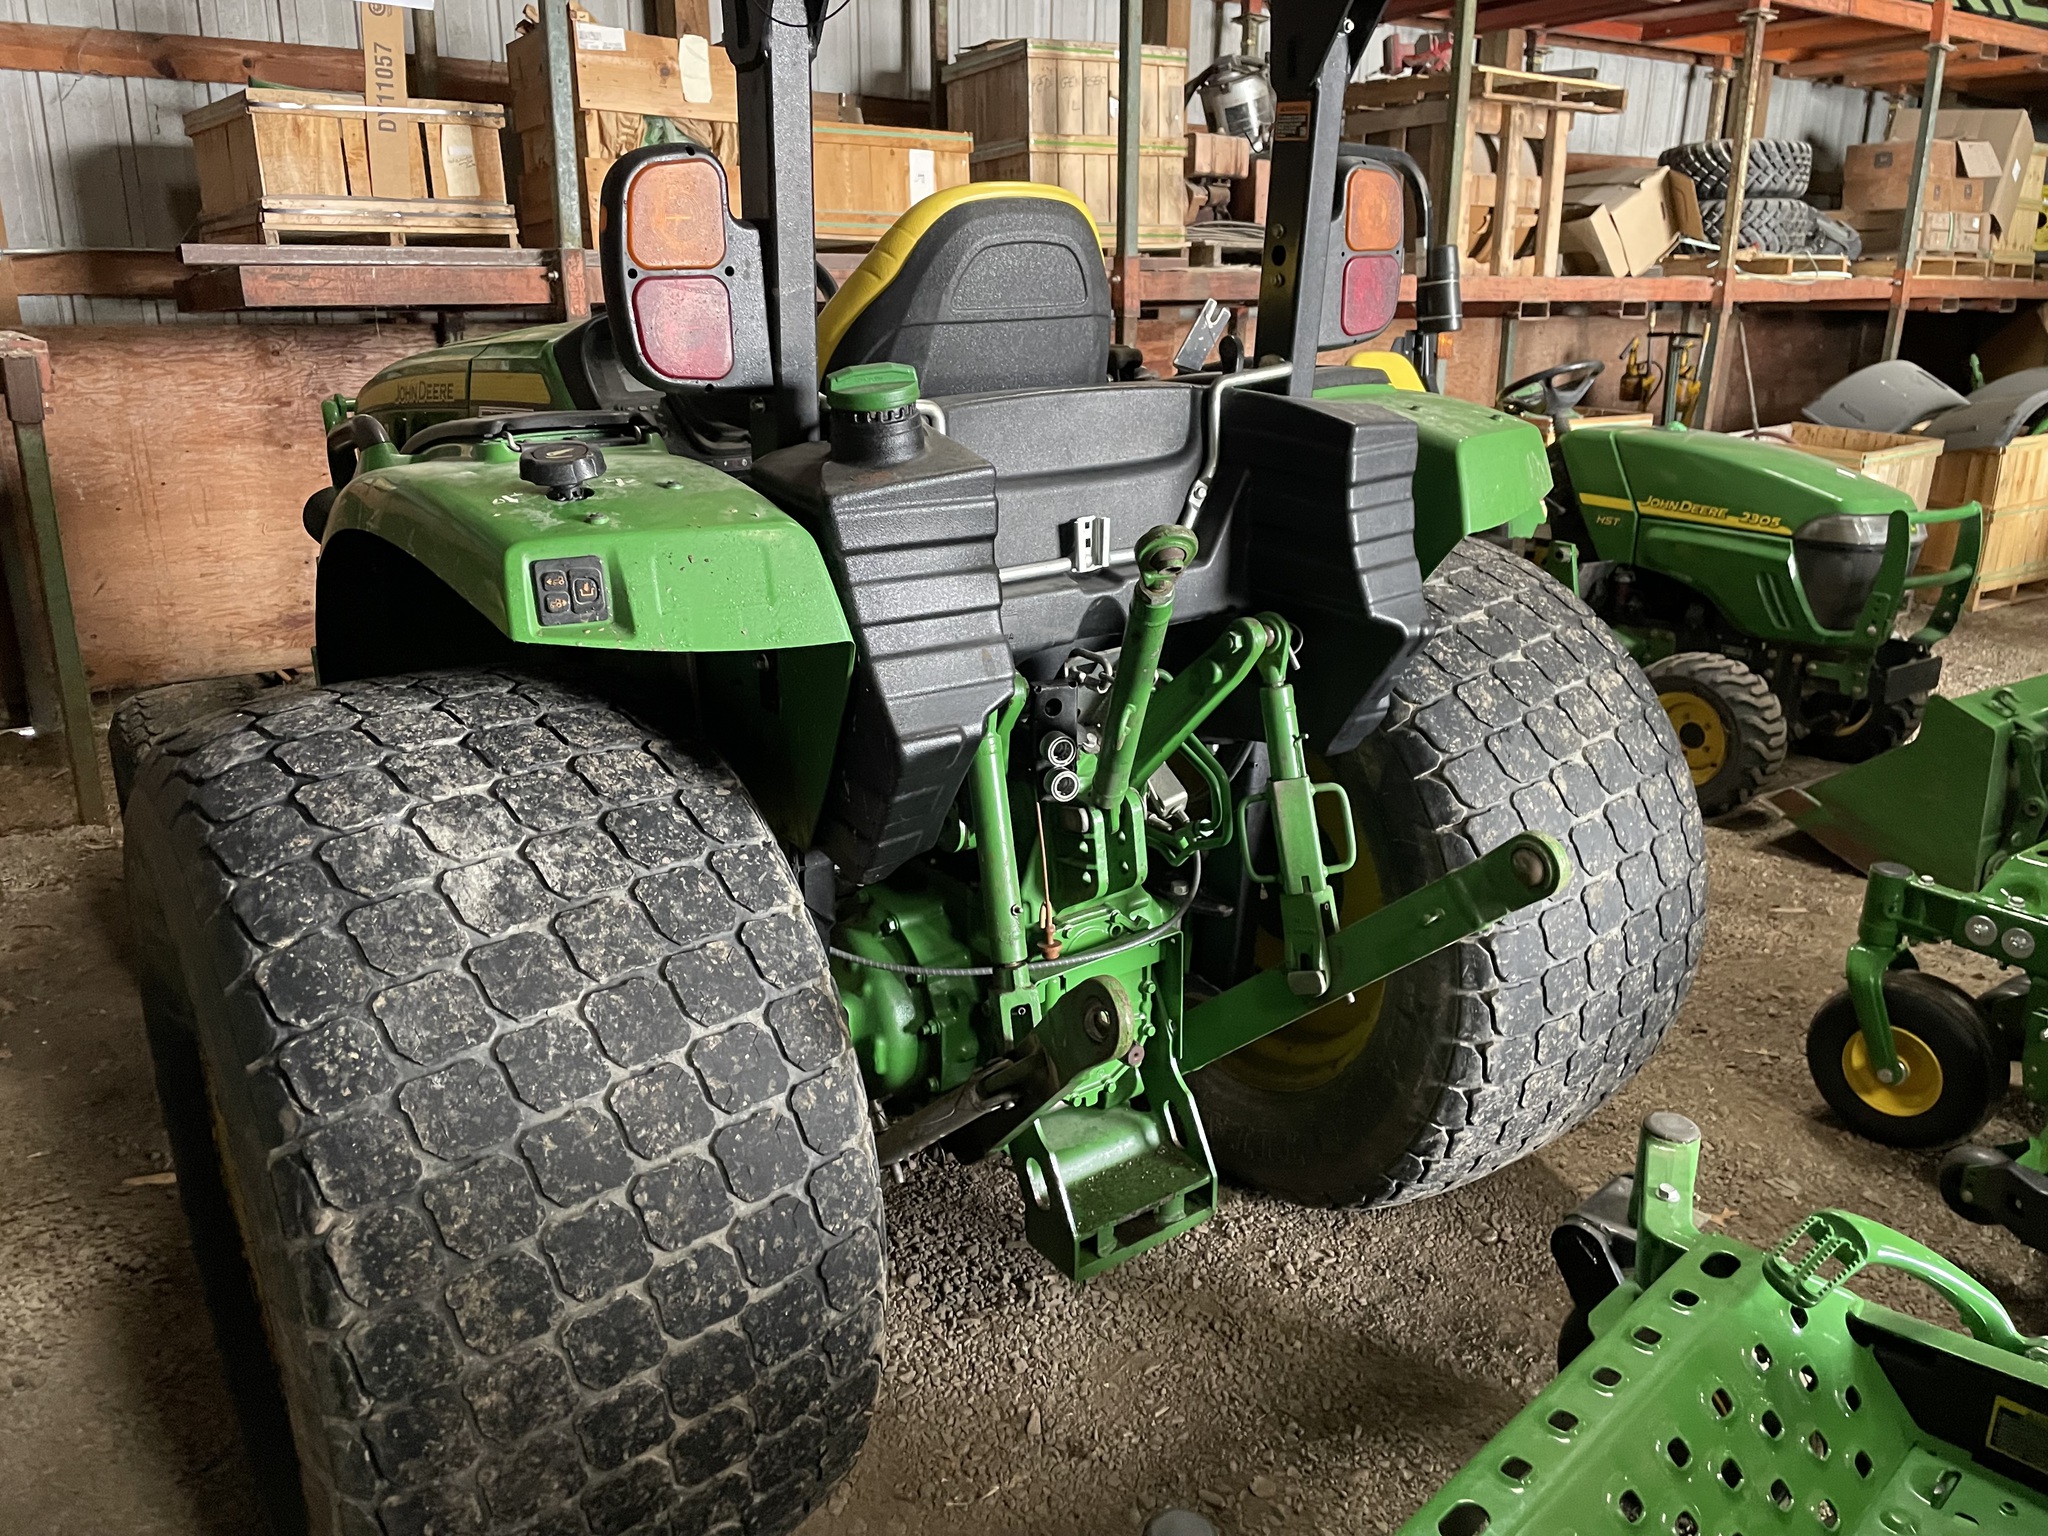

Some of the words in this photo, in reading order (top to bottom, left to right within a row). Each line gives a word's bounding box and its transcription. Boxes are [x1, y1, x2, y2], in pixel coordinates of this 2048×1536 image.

[395, 383, 418, 403] JOHN
[418, 380, 455, 402] DEERE
[1596, 514, 1621, 527] HST
[1640, 495, 1680, 512] JOHN
[1679, 500, 1729, 519] DEERE
[1738, 511, 1782, 528] 2305
